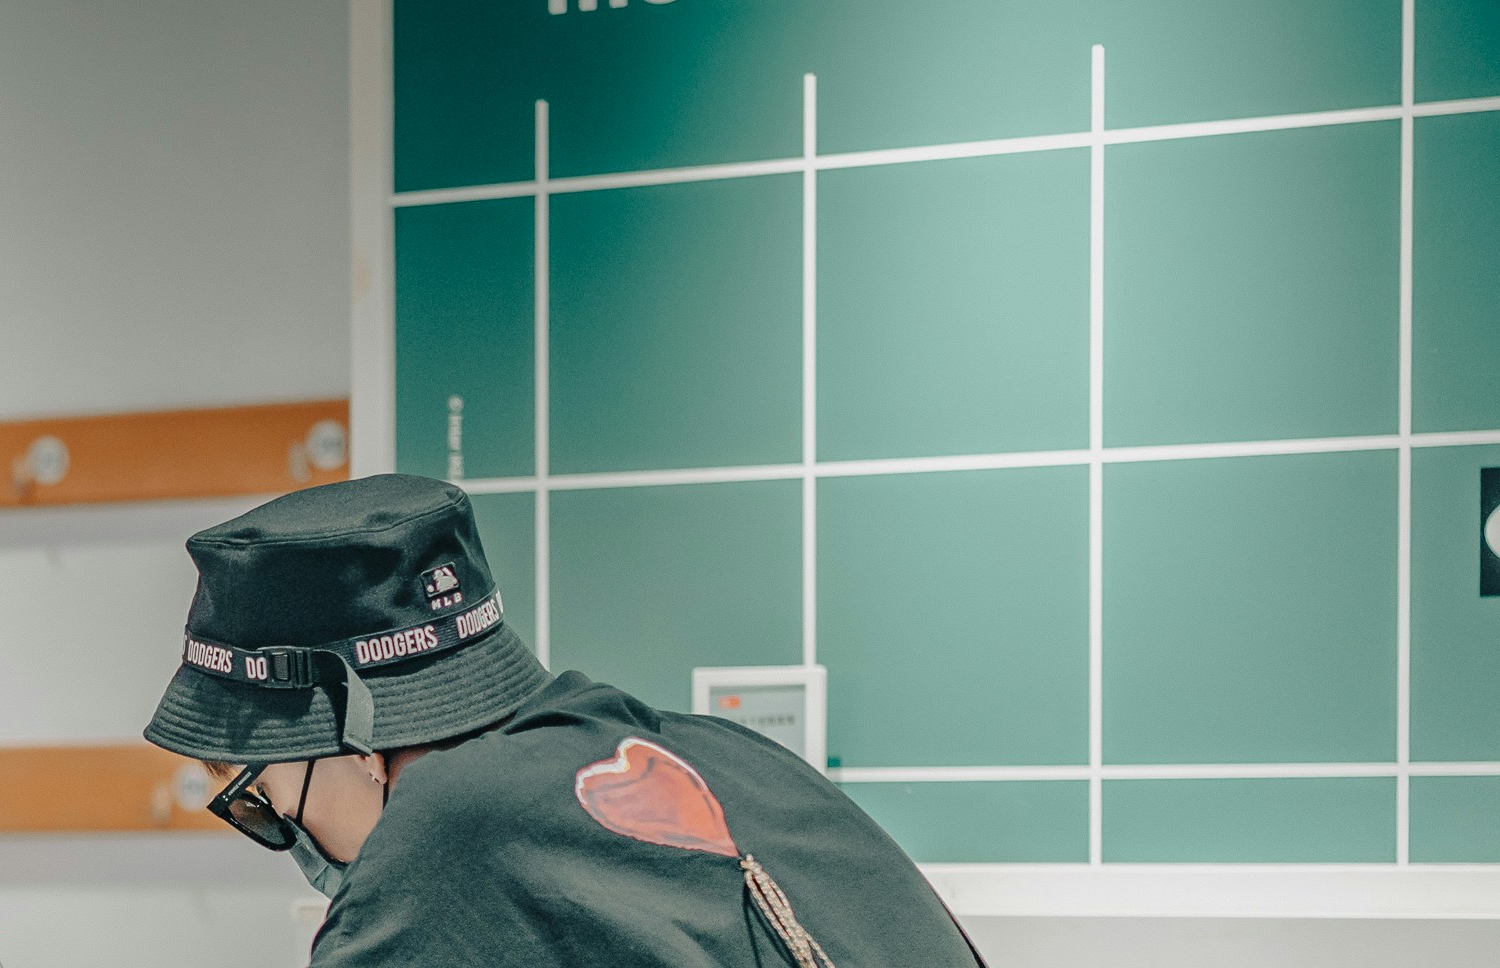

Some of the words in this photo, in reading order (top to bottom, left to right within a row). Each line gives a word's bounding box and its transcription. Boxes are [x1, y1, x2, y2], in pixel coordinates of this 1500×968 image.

[431, 592, 462, 610] MLB
[187, 639, 233, 673] DODGERS
[355, 624, 438, 664] DODGERS
[456, 600, 500, 639] DODGERS
